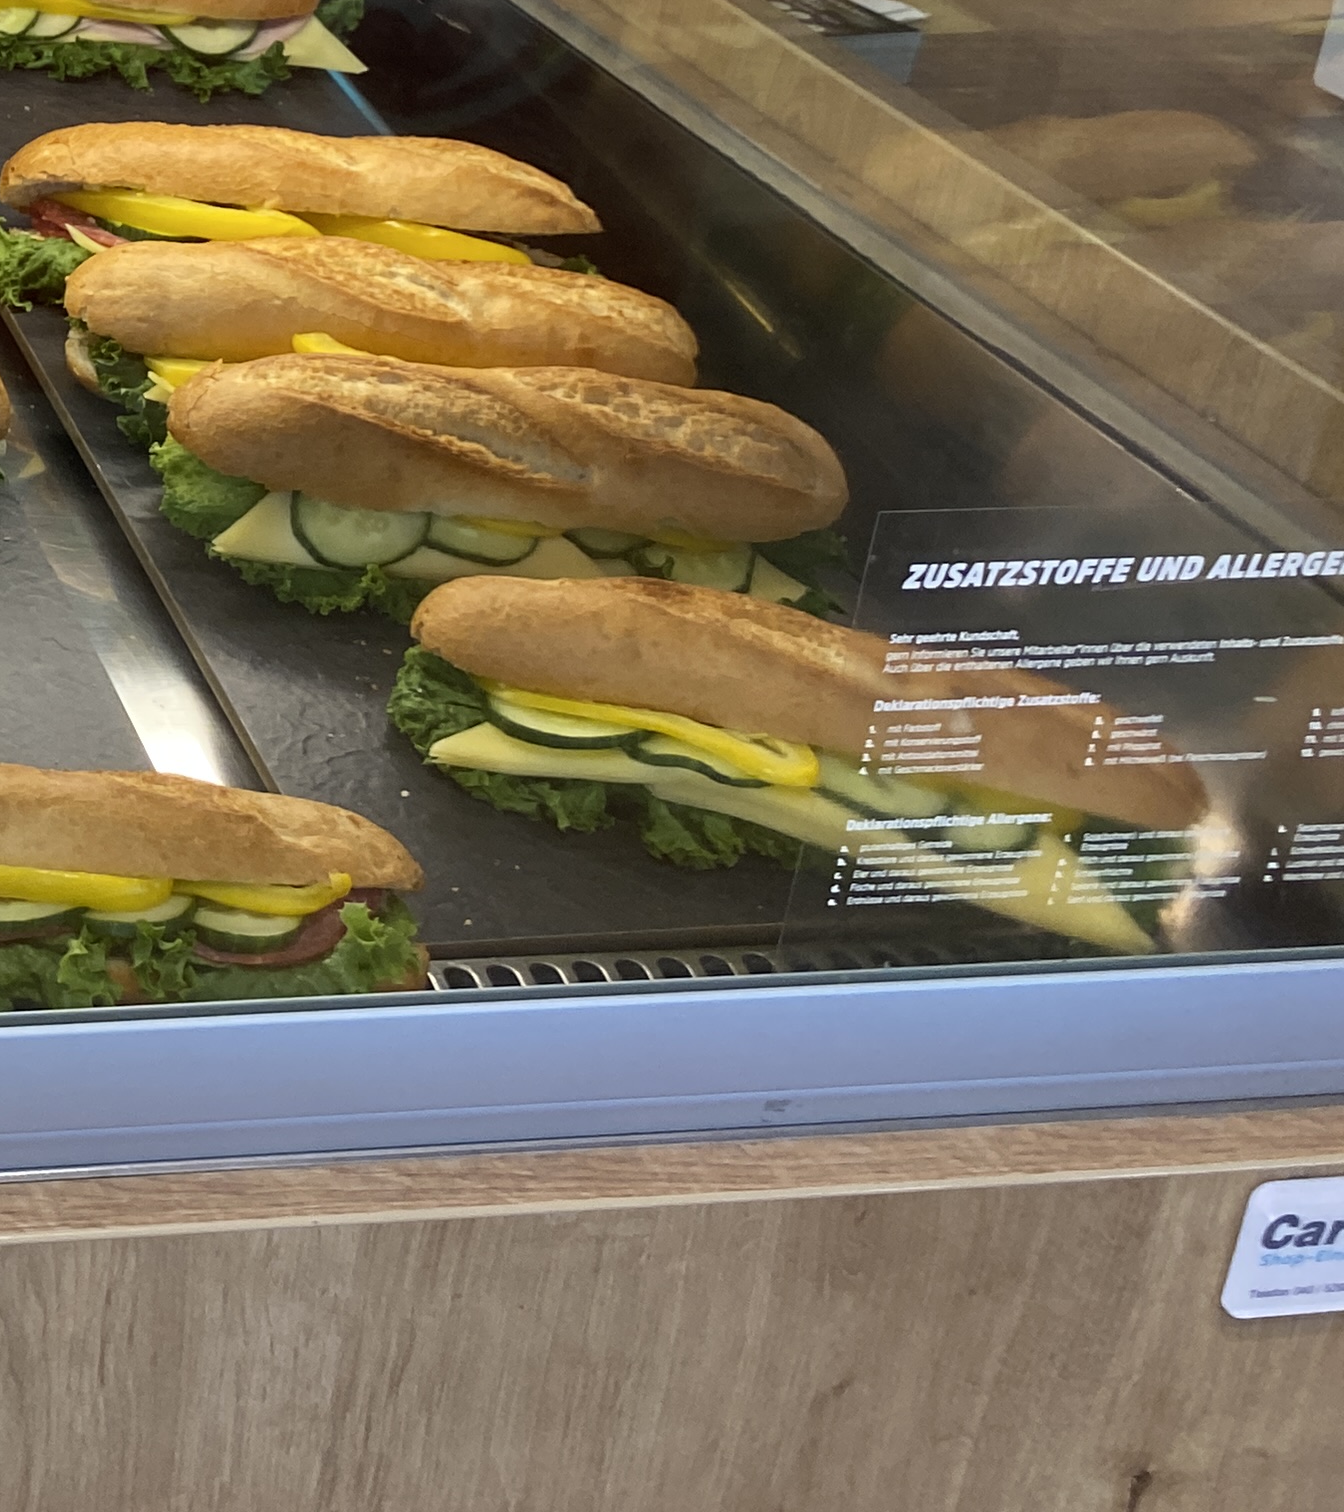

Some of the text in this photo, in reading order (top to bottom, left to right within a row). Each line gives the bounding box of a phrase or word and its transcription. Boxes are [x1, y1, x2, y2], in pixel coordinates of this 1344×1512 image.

[902, 550, 1344, 590] ZUSATZSTOFFE UND ALLERGE
